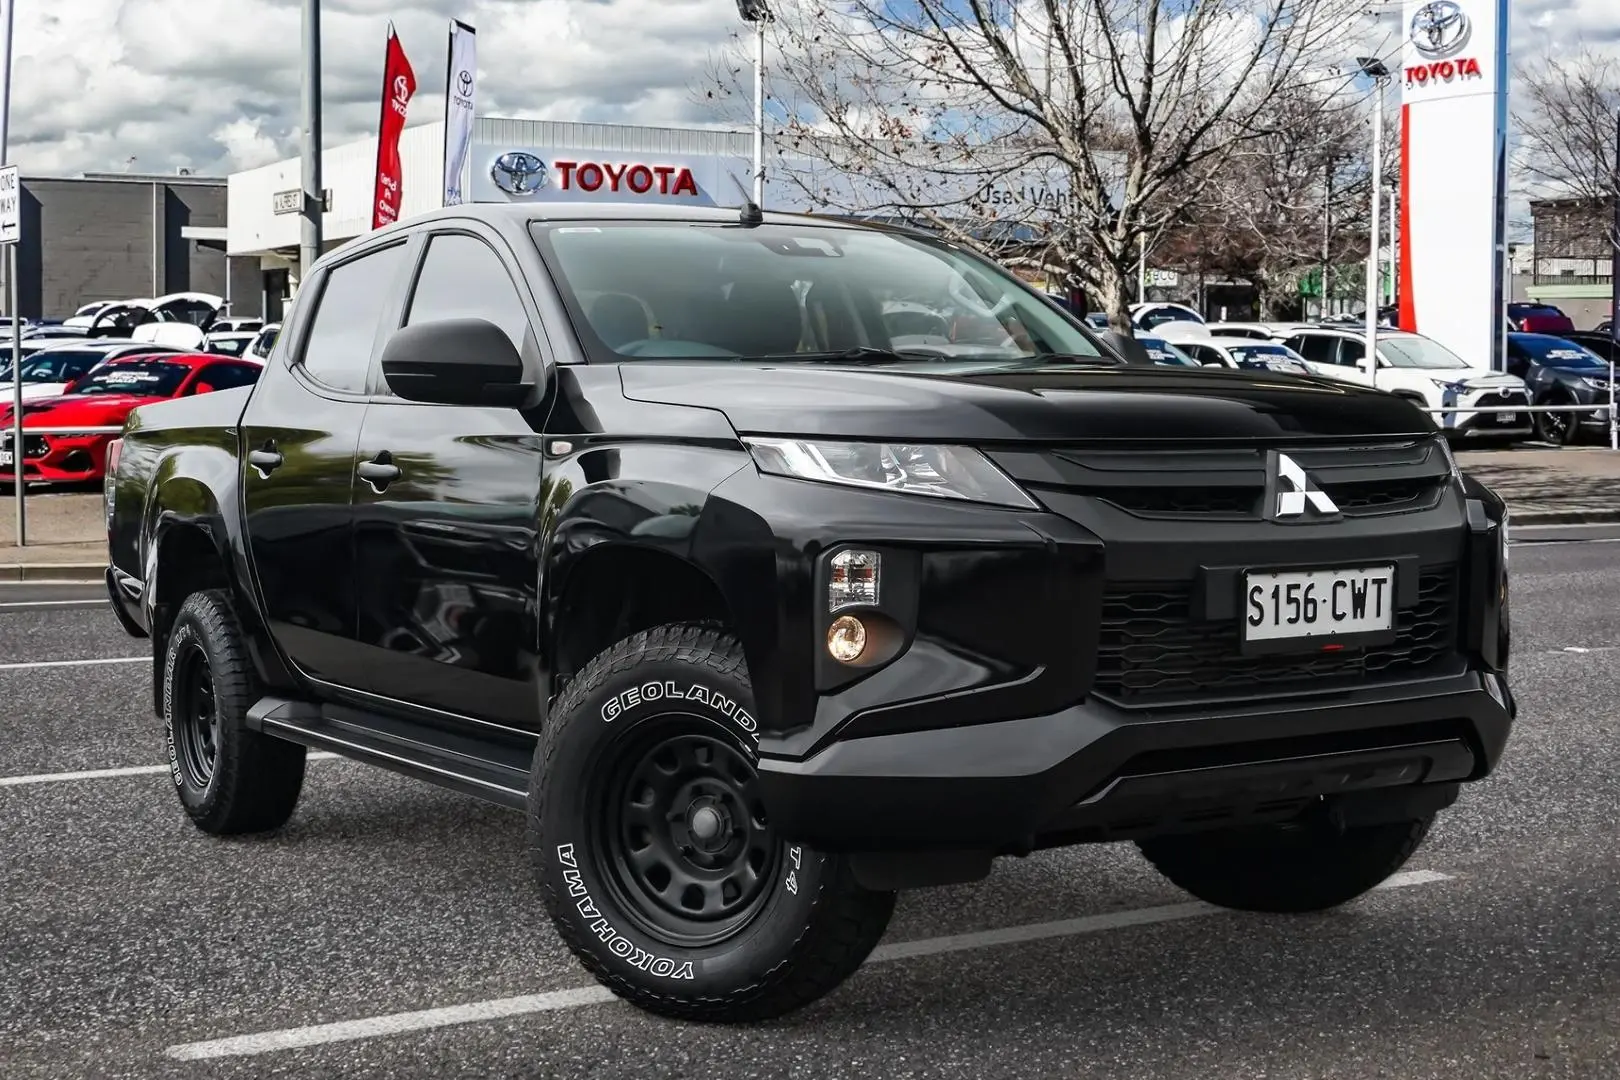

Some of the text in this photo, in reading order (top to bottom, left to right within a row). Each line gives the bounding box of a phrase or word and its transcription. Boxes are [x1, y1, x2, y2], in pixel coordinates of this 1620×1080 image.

[1404, 58, 1481, 83] TOYOTA
[1, 173, 15, 191] ONE
[555, 161, 698, 196] TOYOTA
[1, 196, 16, 214] WAY
[557, 843, 695, 980] YOKOHAMA
